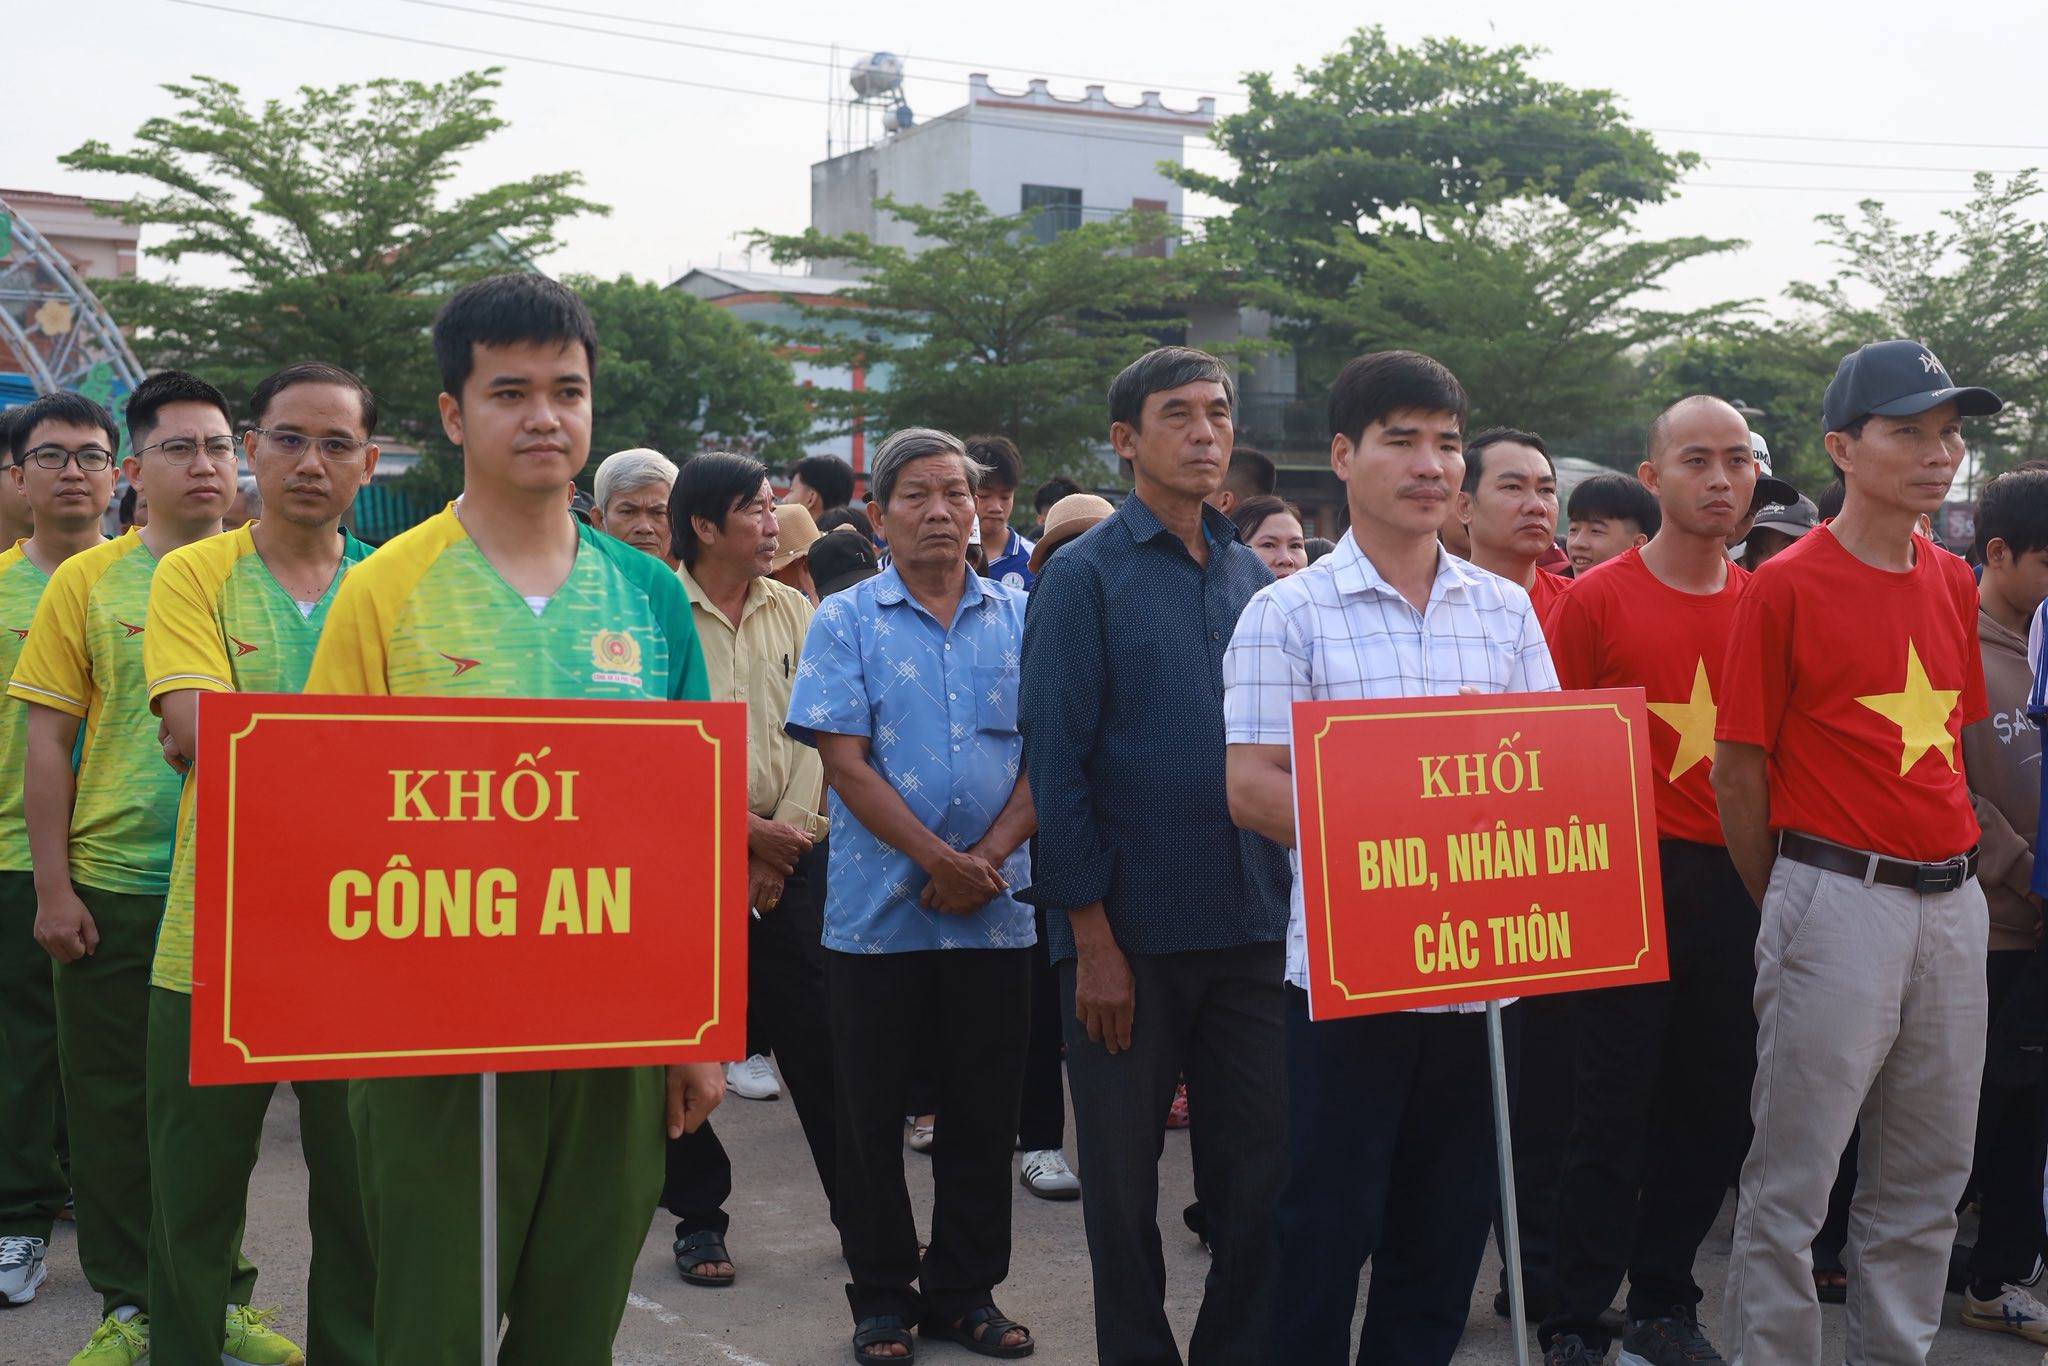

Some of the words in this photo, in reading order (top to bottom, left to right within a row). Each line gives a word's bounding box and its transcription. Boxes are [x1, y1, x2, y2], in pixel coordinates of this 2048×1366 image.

[387, 747, 580, 823] KHỐI
[1418, 731, 1544, 799] KHỐI
[1358, 837, 1439, 895] BND,
[1446, 820, 1537, 883] NHÂN
[1544, 815, 1610, 875] DÂN
[328, 854, 517, 940] CÔNG
[539, 867, 631, 935] AN
[1413, 911, 1480, 974] CÁC
[1487, 903, 1572, 966] THÔN
